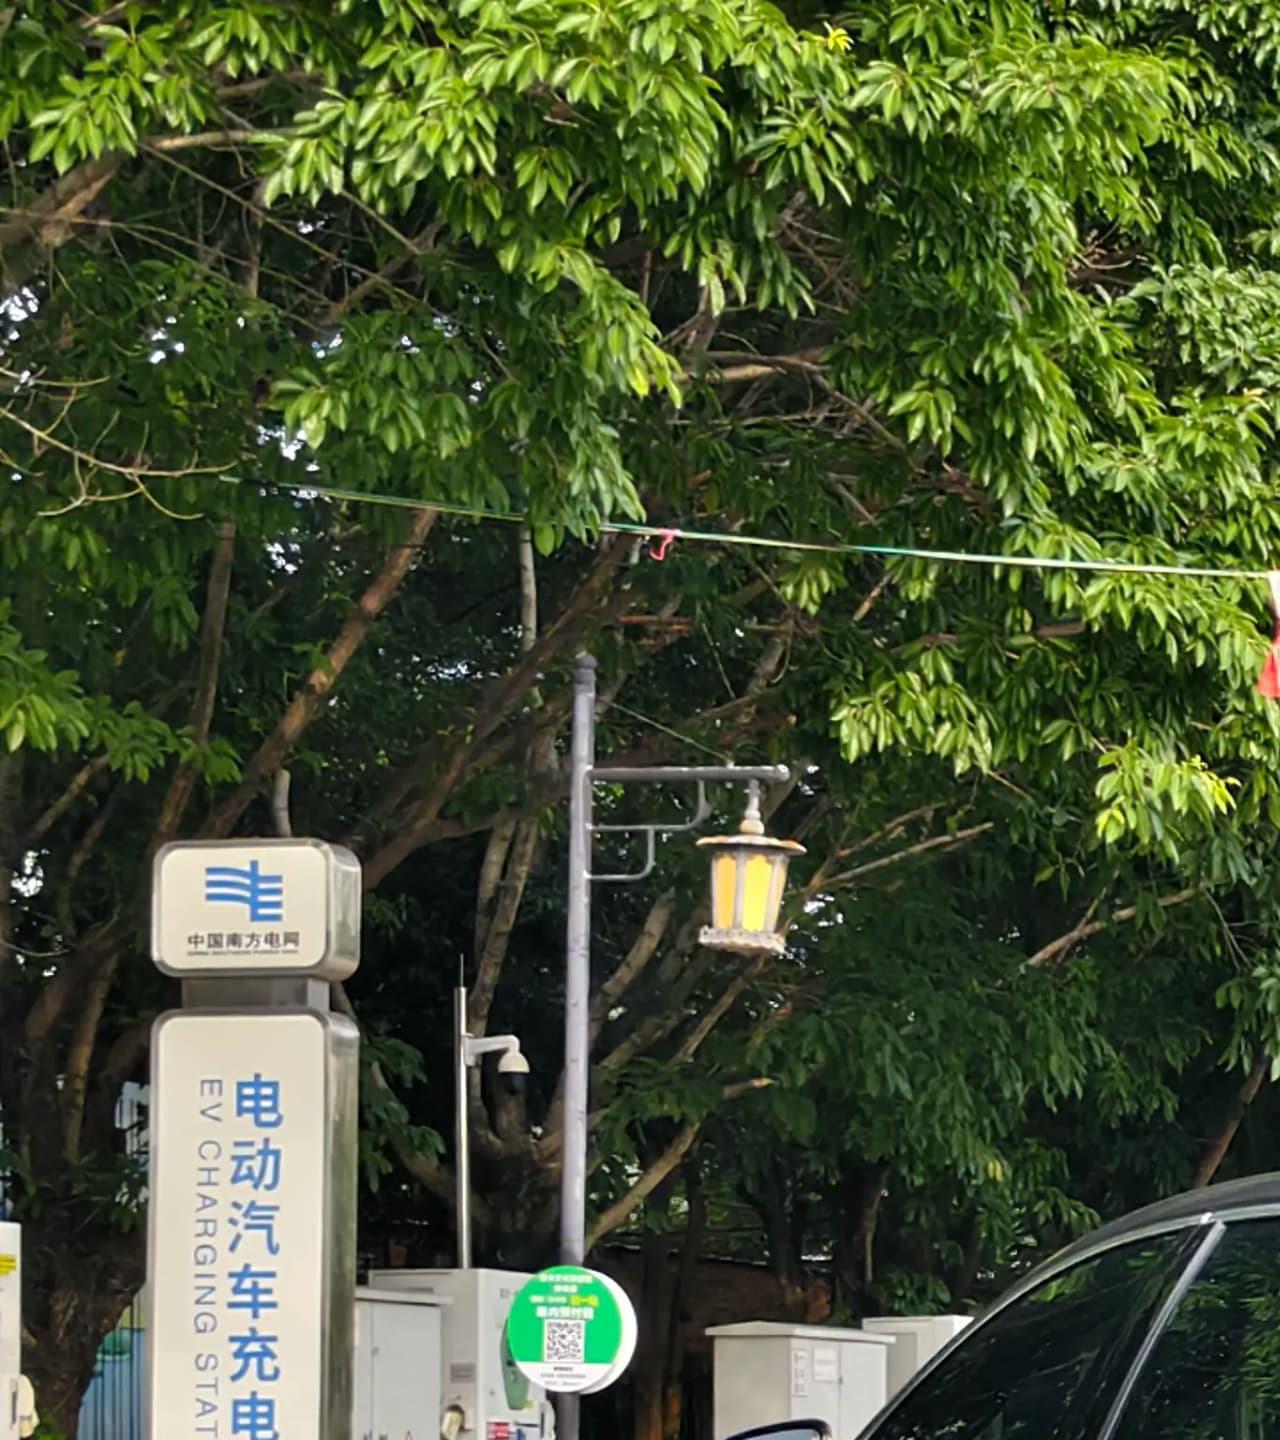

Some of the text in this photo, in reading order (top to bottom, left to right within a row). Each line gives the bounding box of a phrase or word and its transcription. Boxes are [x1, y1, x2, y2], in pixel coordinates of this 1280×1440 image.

[187, 931, 300, 949] 中国南方电网
[200, 1079, 223, 1122] EV
[193, 1140, 222, 1333] CHARGING
